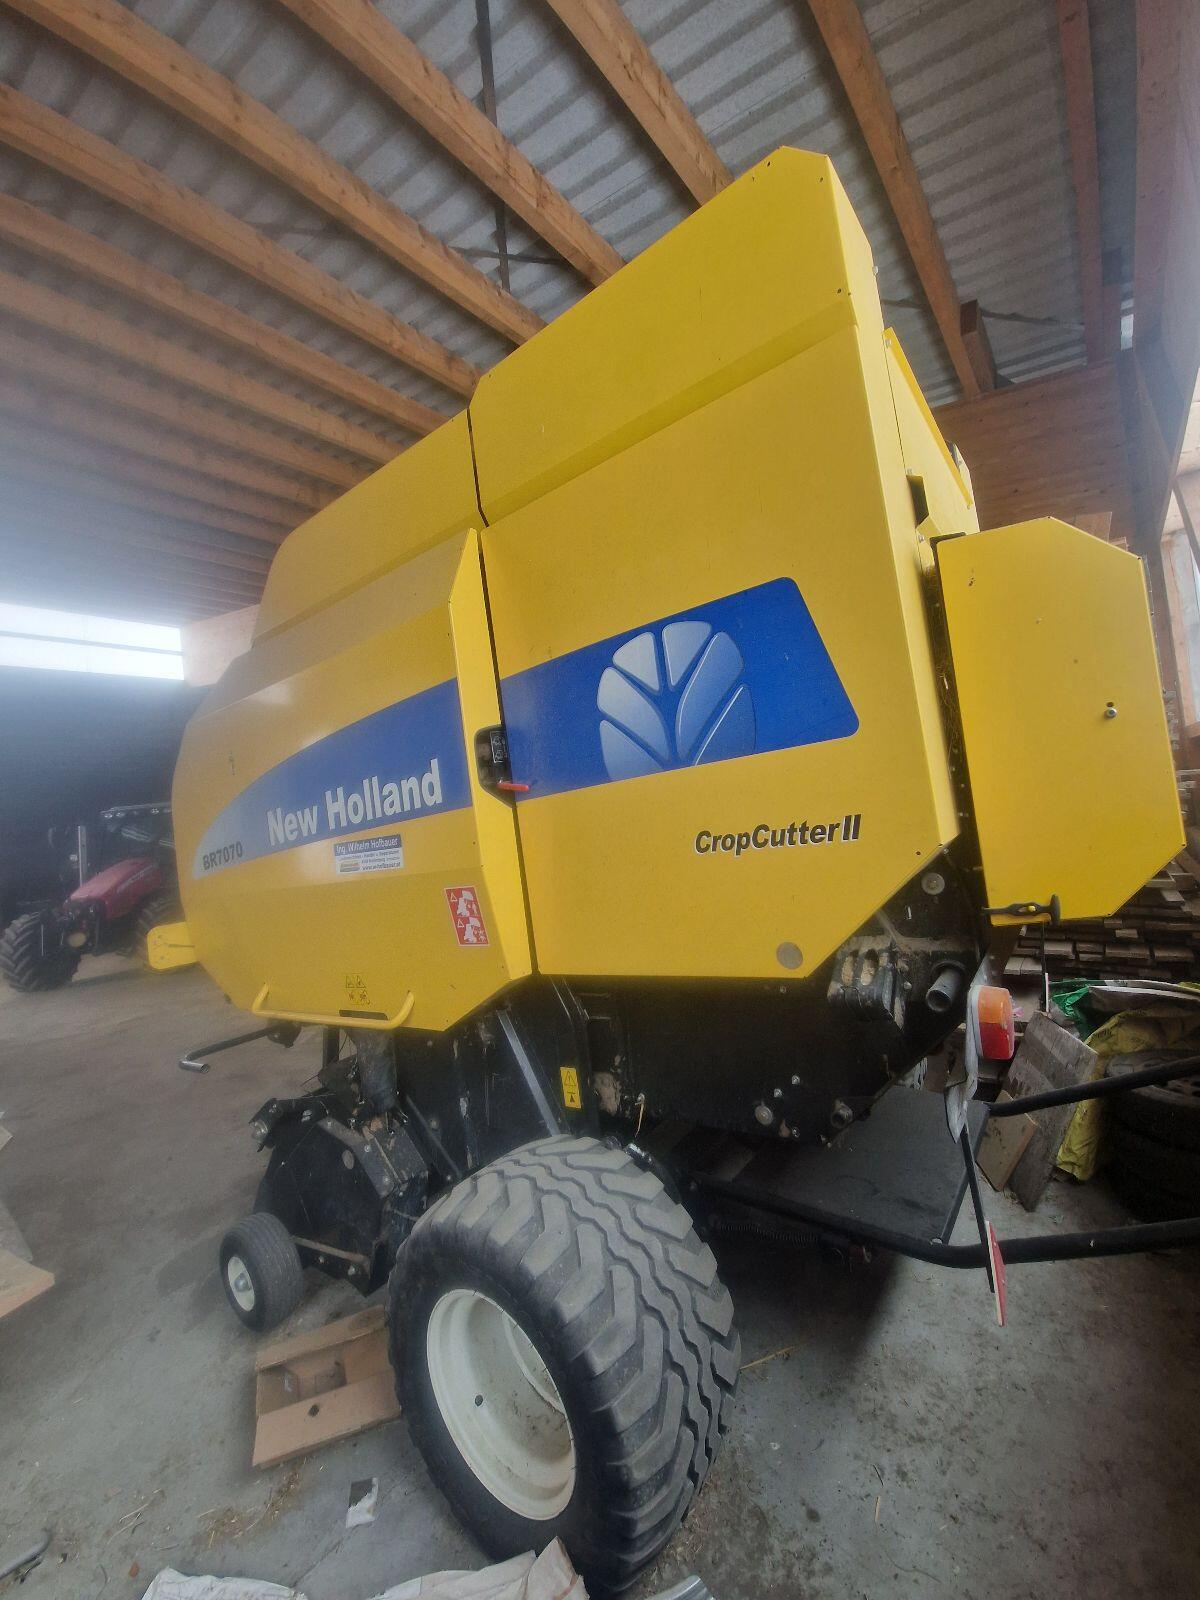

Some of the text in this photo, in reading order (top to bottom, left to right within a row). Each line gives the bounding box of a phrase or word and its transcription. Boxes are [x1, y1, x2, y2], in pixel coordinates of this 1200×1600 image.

[267, 758, 442, 846] New Holland
[203, 841, 243, 871] BR7070
[370, 838, 398, 850] Hofbauer
